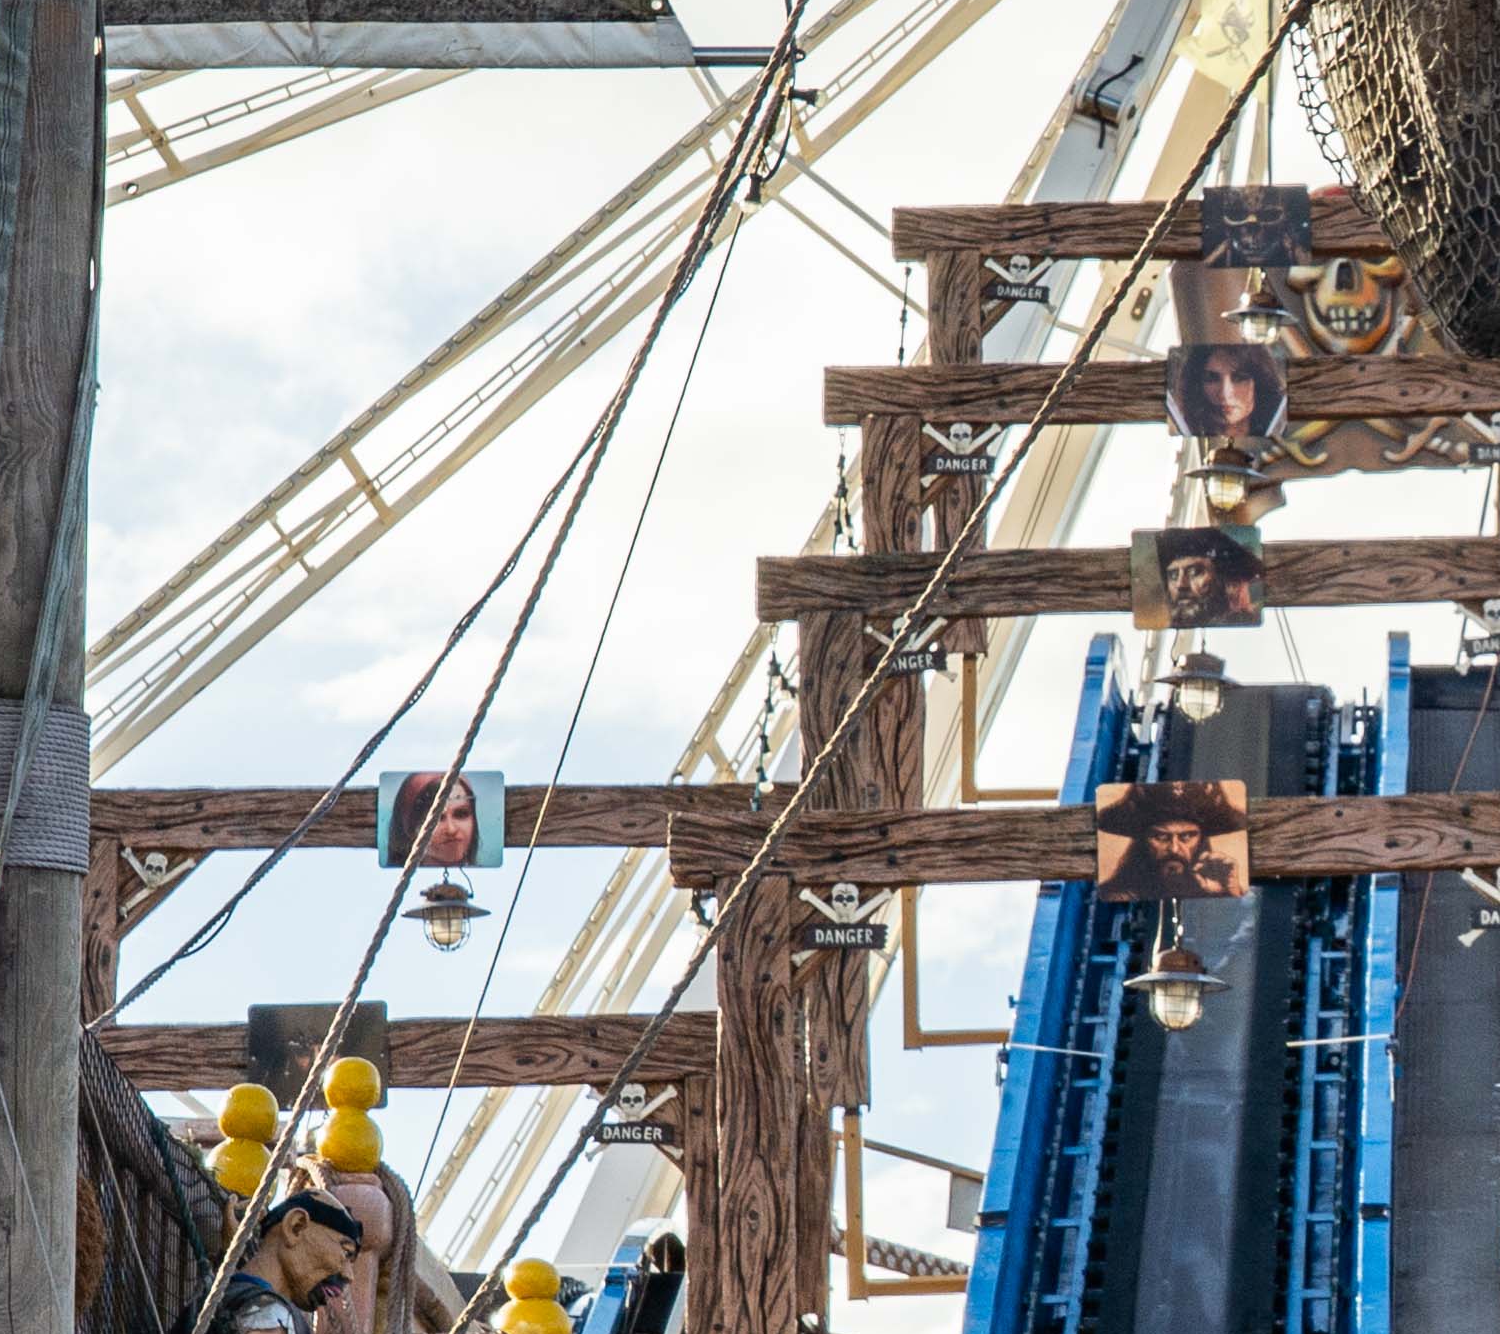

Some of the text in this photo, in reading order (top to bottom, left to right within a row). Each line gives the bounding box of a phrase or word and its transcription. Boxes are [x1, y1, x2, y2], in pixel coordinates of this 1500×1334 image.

[935, 457, 988, 471] DANGER
[888, 653, 934, 672] ANGER
[814, 928, 874, 945] DANGER
[602, 1125, 663, 1141] DANGER
